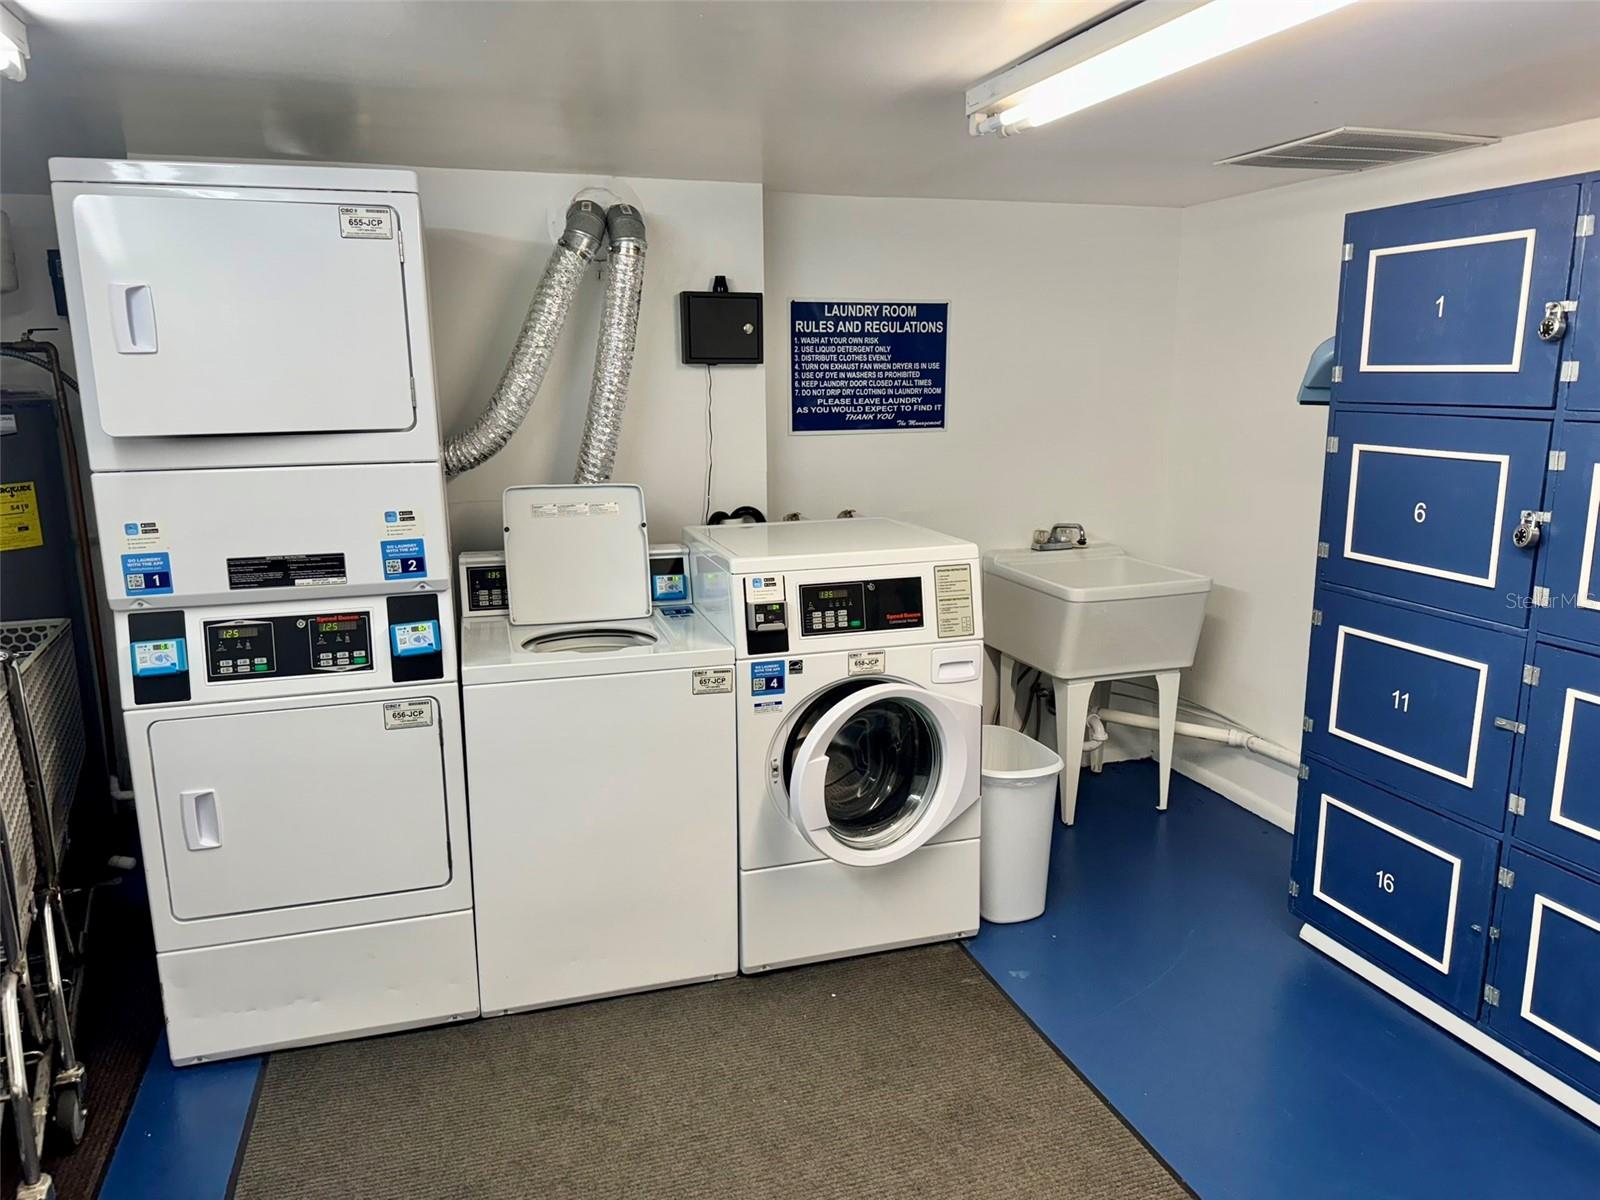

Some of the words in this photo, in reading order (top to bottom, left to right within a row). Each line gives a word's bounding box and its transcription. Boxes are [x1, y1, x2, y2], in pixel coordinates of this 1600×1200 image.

[824, 305, 879, 317] LAUNDRY
[882, 305, 916, 317] ROOM
[1436, 296, 1444, 318] 1
[796, 321, 834, 333] RULES
[837, 321, 861, 333] AND
[865, 321, 943, 333] REGULATIONS
[1415, 502, 1426, 523] 6
[408, 560, 417, 571] 2
[153, 574, 160, 586] 1
[770, 678, 778, 688] 4
[1392, 690, 1409, 712] 11
[392, 710, 424, 719] 656-JCP
[1376, 870, 1394, 893] 16
